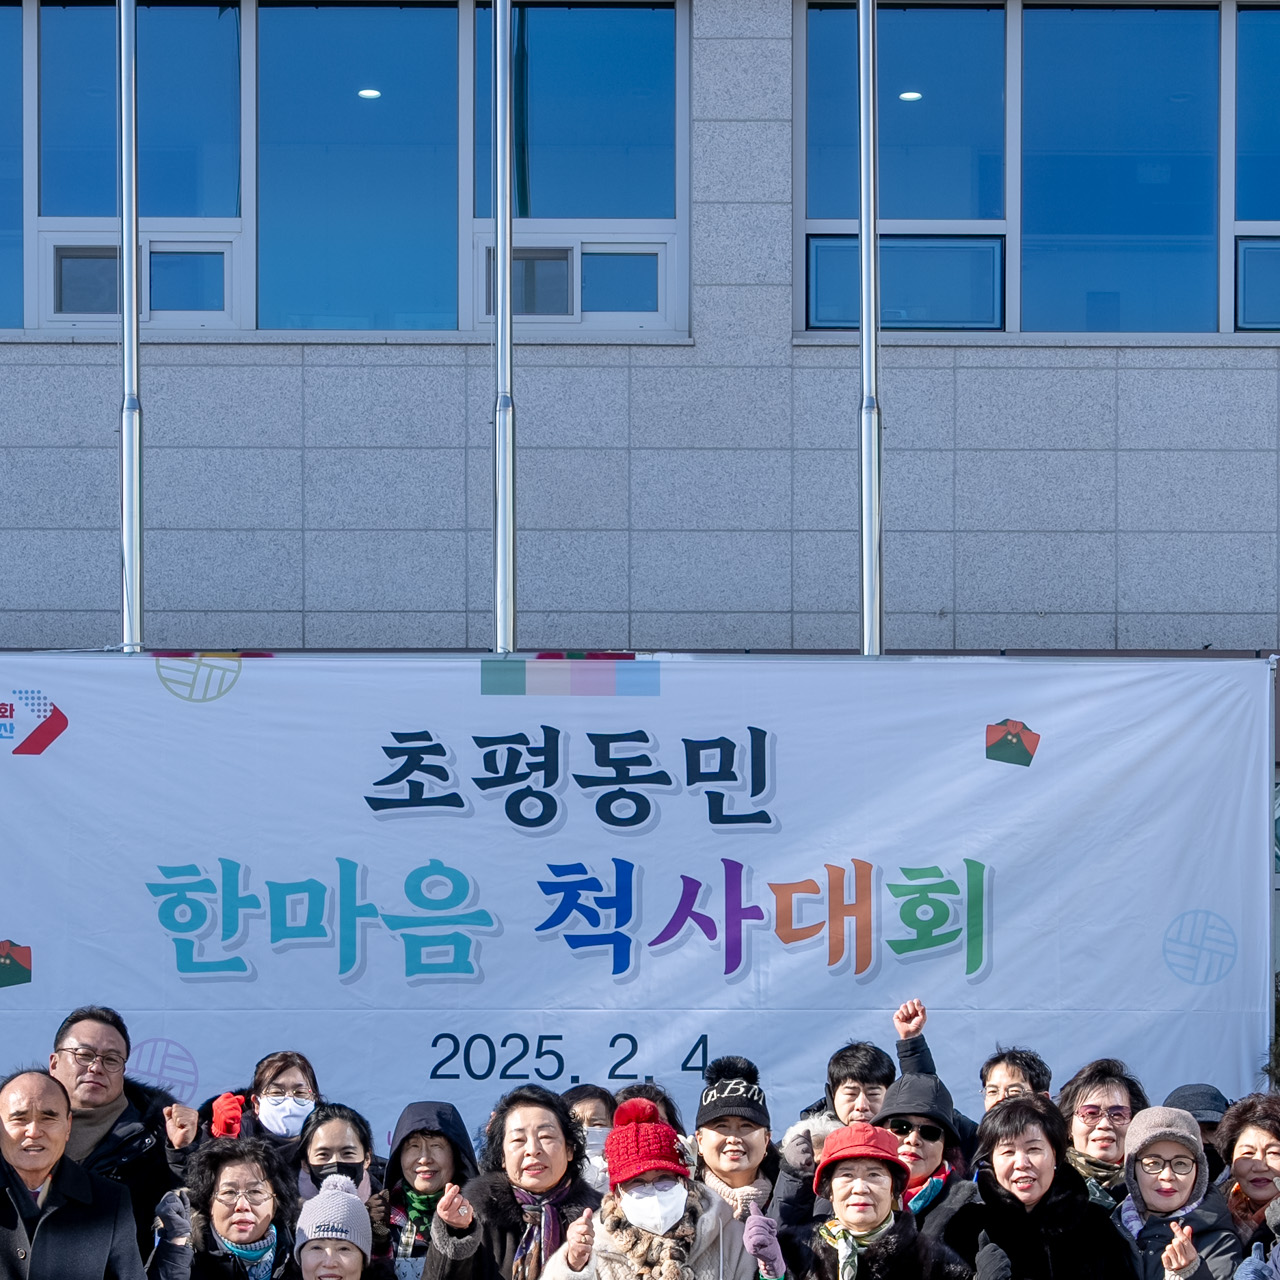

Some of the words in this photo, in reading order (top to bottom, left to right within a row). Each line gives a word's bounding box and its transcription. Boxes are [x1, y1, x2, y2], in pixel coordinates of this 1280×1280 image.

[363, 726, 775, 835] 초평동민
[144, 856, 500, 982] 한마음
[534, 856, 992, 982] 척사대회
[429, 1032, 580, 1084] 2025.
[607, 1032, 654, 1084] 2.
